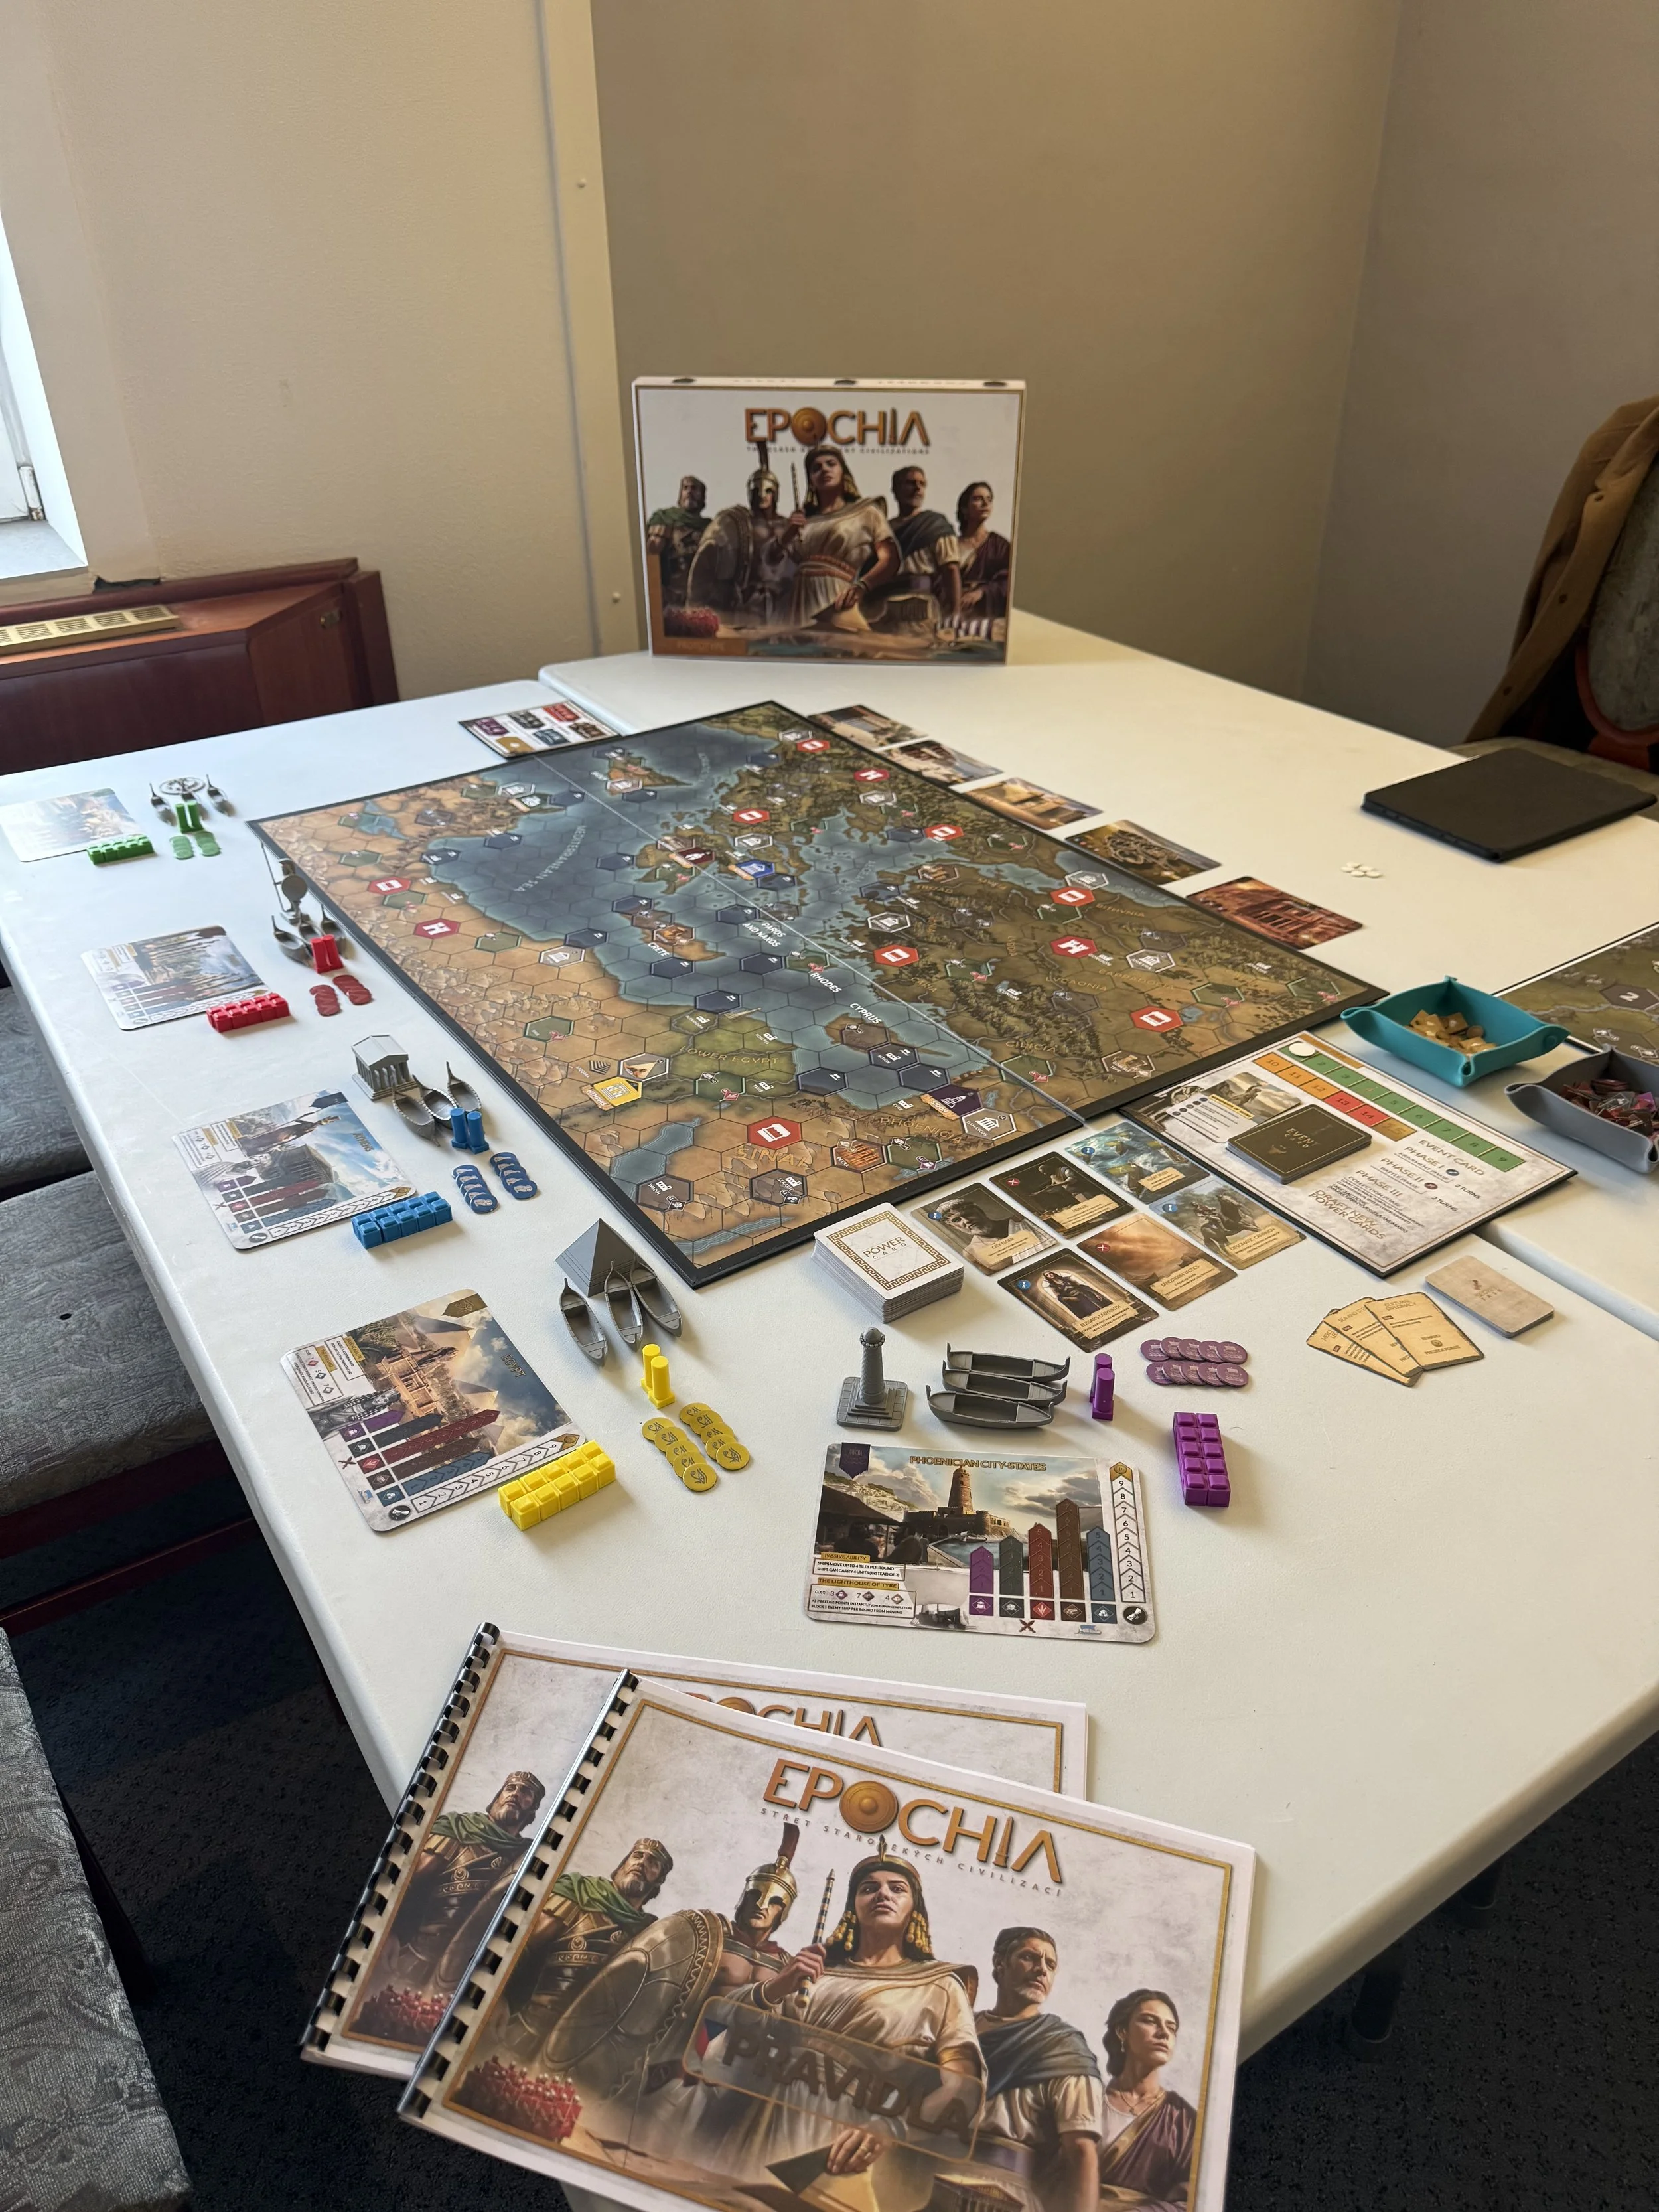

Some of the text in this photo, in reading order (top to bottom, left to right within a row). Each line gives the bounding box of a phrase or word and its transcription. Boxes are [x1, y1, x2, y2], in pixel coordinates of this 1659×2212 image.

[745, 406, 930, 446] EPOCHIA
[742, 923, 781, 948] AND NAXOS
[761, 922, 786, 938] PAROS
[648, 942, 670, 957] CRETE
[810, 972, 842, 993] RHODES
[1045, 976, 1108, 992] LYCAONIA
[849, 1003, 882, 1024] CYPRUS
[680, 1046, 778, 1064] LOWER EGYPT
[1005, 1041, 1057, 1053] CILICIA
[587, 1089, 607, 1106] MEMPHIS
[931, 1100, 948, 1113] SIDON
[893, 1103, 902, 1112] TYRE
[880, 1117, 962, 1144] PHOENICIA
[966, 1120, 988, 1137] DAMASCUS
[1287, 1128, 1318, 1146] EVENT
[734, 1148, 807, 1167] SINAI
[836, 1157, 849, 1167] PETRA
[1404, 1147, 1440, 1168] PHASE
[1419, 1140, 1484, 1176] EVENT CARD
[1381, 1158, 1417, 1179] PHASE
[1356, 1170, 1391, 1190] PHASE
[1459, 1185, 1481, 1199] TURNS
[1313, 1189, 1379, 1226] DRAFT NEW
[1436, 1197, 1458, 1212] TURNS
[1309, 1193, 1348, 1218] POWER
[1348, 1216, 1386, 1240] CARDS
[863, 1237, 905, 1257] POWER
[873, 1243, 906, 1259] CARD
[501, 1354, 526, 1378] EGYPT
[910, 1455, 1046, 1471] PHOENICIAN CITY-STATES
[762, 1757, 1062, 1883] EPOCHIA
[760, 1807, 810, 1828] STŘET
[823, 1825, 944, 1864] STAROĚKÝCH
[722, 2024, 972, 2144] PRAVIDLA
